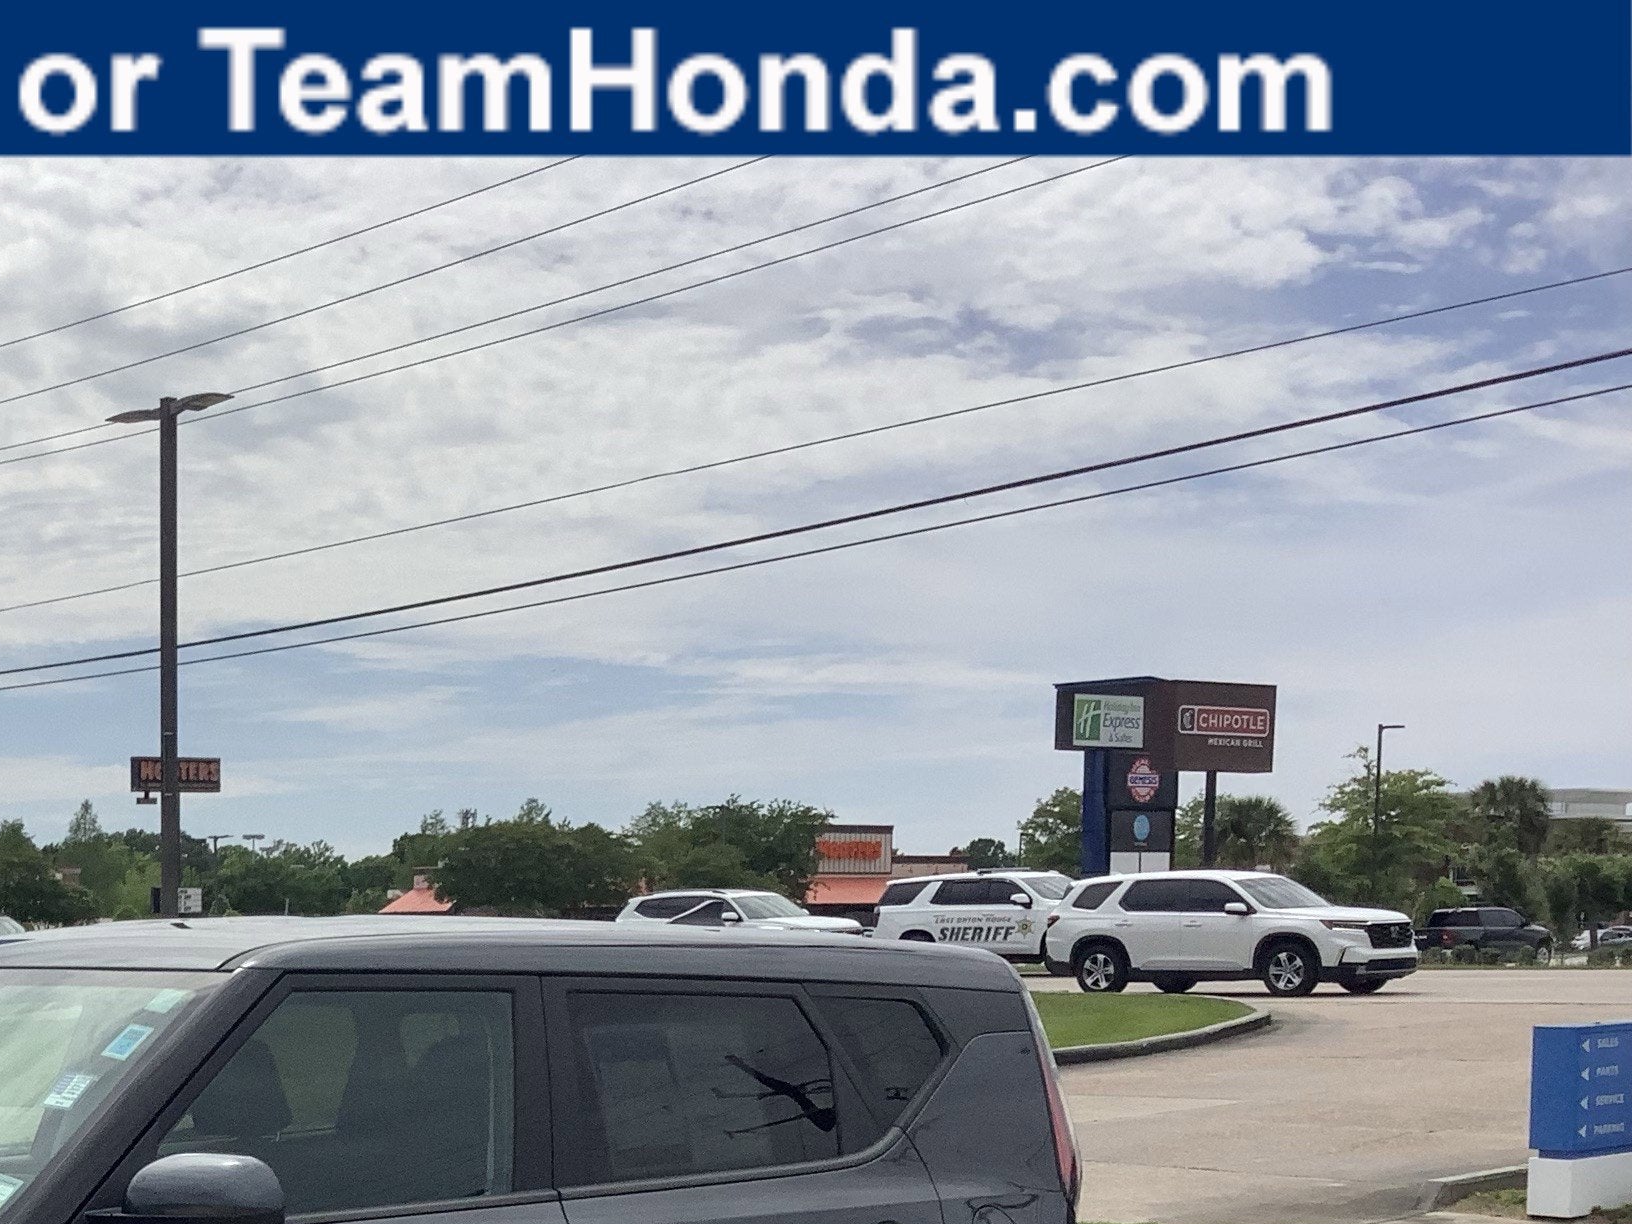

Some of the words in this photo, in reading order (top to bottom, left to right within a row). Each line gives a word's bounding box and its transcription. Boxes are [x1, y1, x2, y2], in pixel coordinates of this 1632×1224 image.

[1103, 713, 1141, 731] Express
[1199, 713, 1266, 730] CHIPOTLE
[140, 760, 219, 781] HOTERS
[938, 926, 1016, 941] SHERIFF
